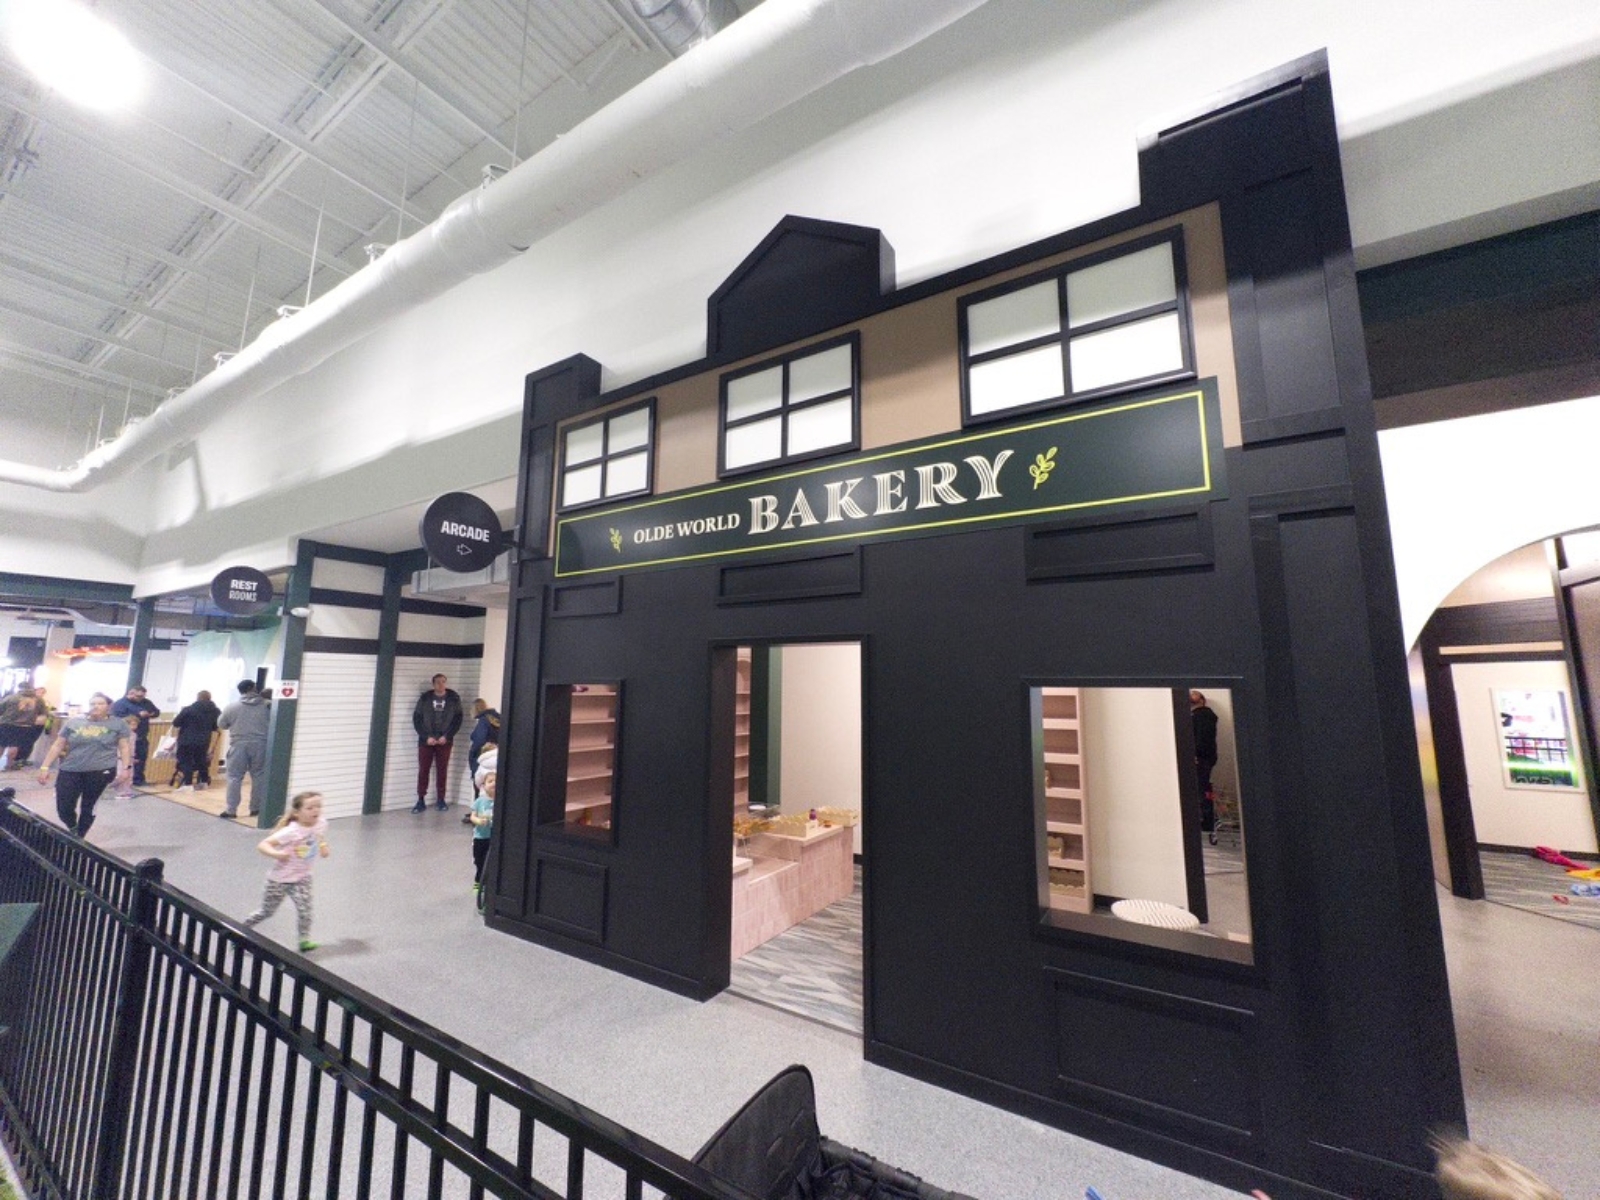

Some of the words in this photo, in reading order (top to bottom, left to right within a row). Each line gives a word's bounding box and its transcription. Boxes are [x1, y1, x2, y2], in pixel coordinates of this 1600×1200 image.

[633, 524, 675, 544] OLDE
[676, 513, 741, 537] WORLD
[748, 449, 1015, 535] BAKERY
[440, 520, 490, 543] ARCADE
[230, 579, 258, 591] REST
[229, 590, 257, 602] ROOMS
